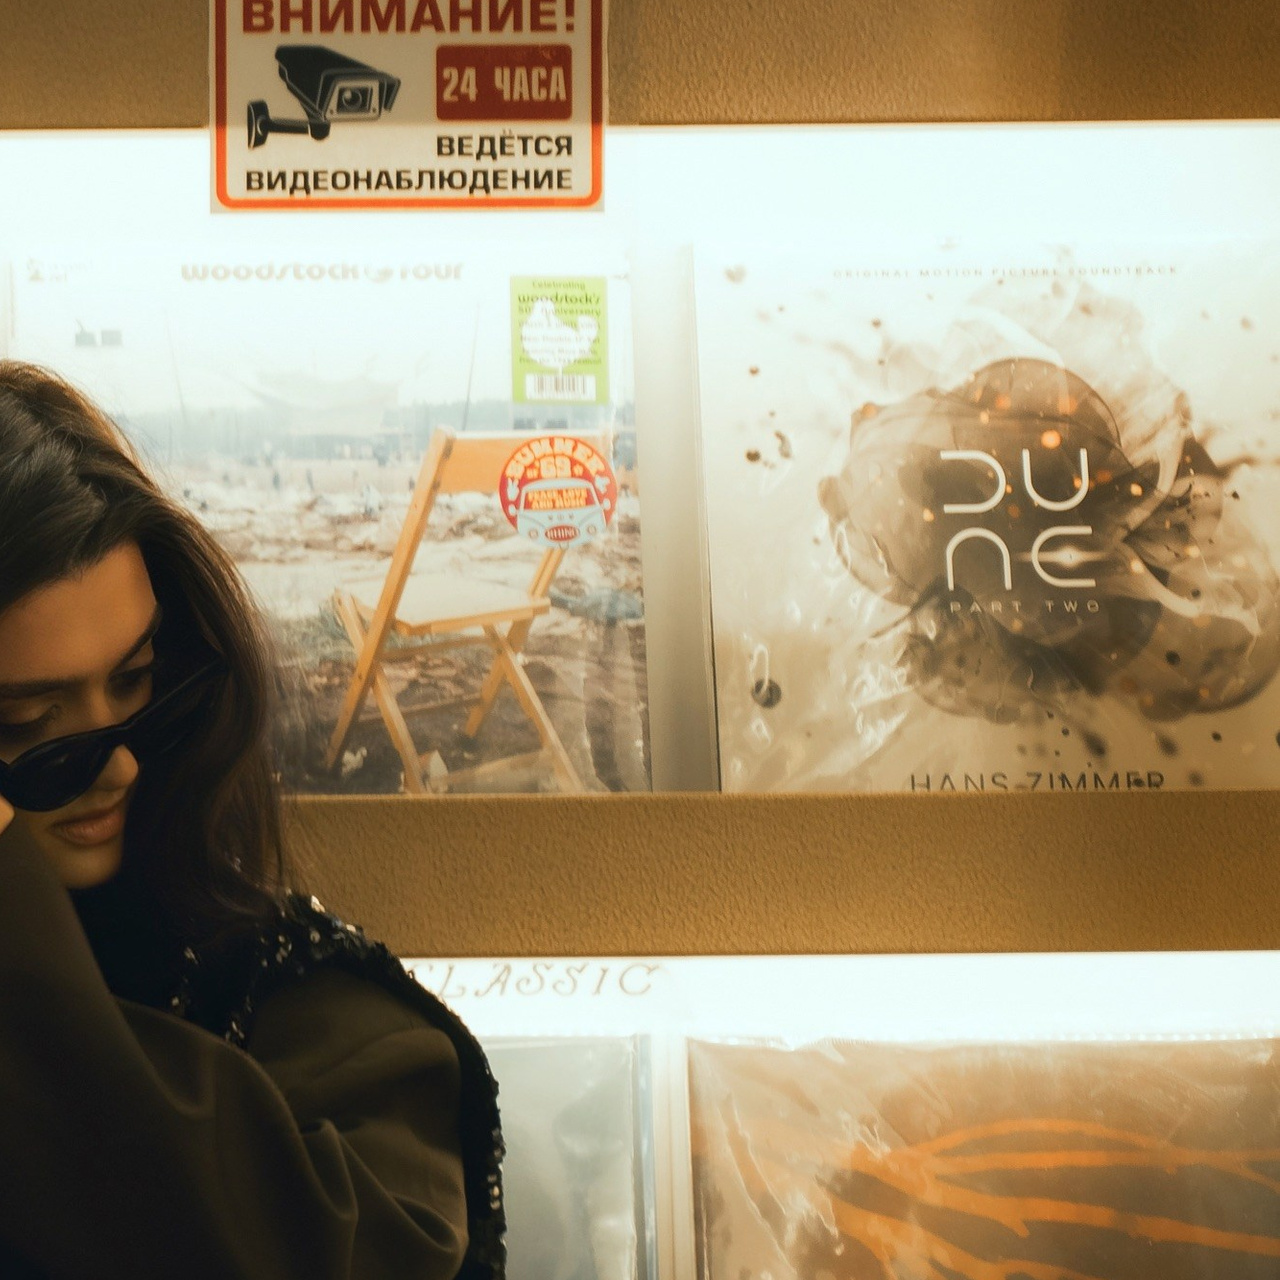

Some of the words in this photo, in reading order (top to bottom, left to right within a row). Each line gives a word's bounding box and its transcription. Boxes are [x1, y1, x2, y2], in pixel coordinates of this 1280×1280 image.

[442, 66, 478, 102] 24
[494, 65, 568, 102] ЧАСА
[436, 129, 573, 161] ВЕДЁТСЯ
[245, 169, 573, 197] ВИДЕОНАБЛЮДЕНИЕ
[505, 437, 606, 479] SUMMER
[950, 600, 1021, 614] PART
[1045, 600, 1100, 613] TWO
[910, 771, 1009, 792] HANS
[1026, 771, 1166, 792] ZIMMER
